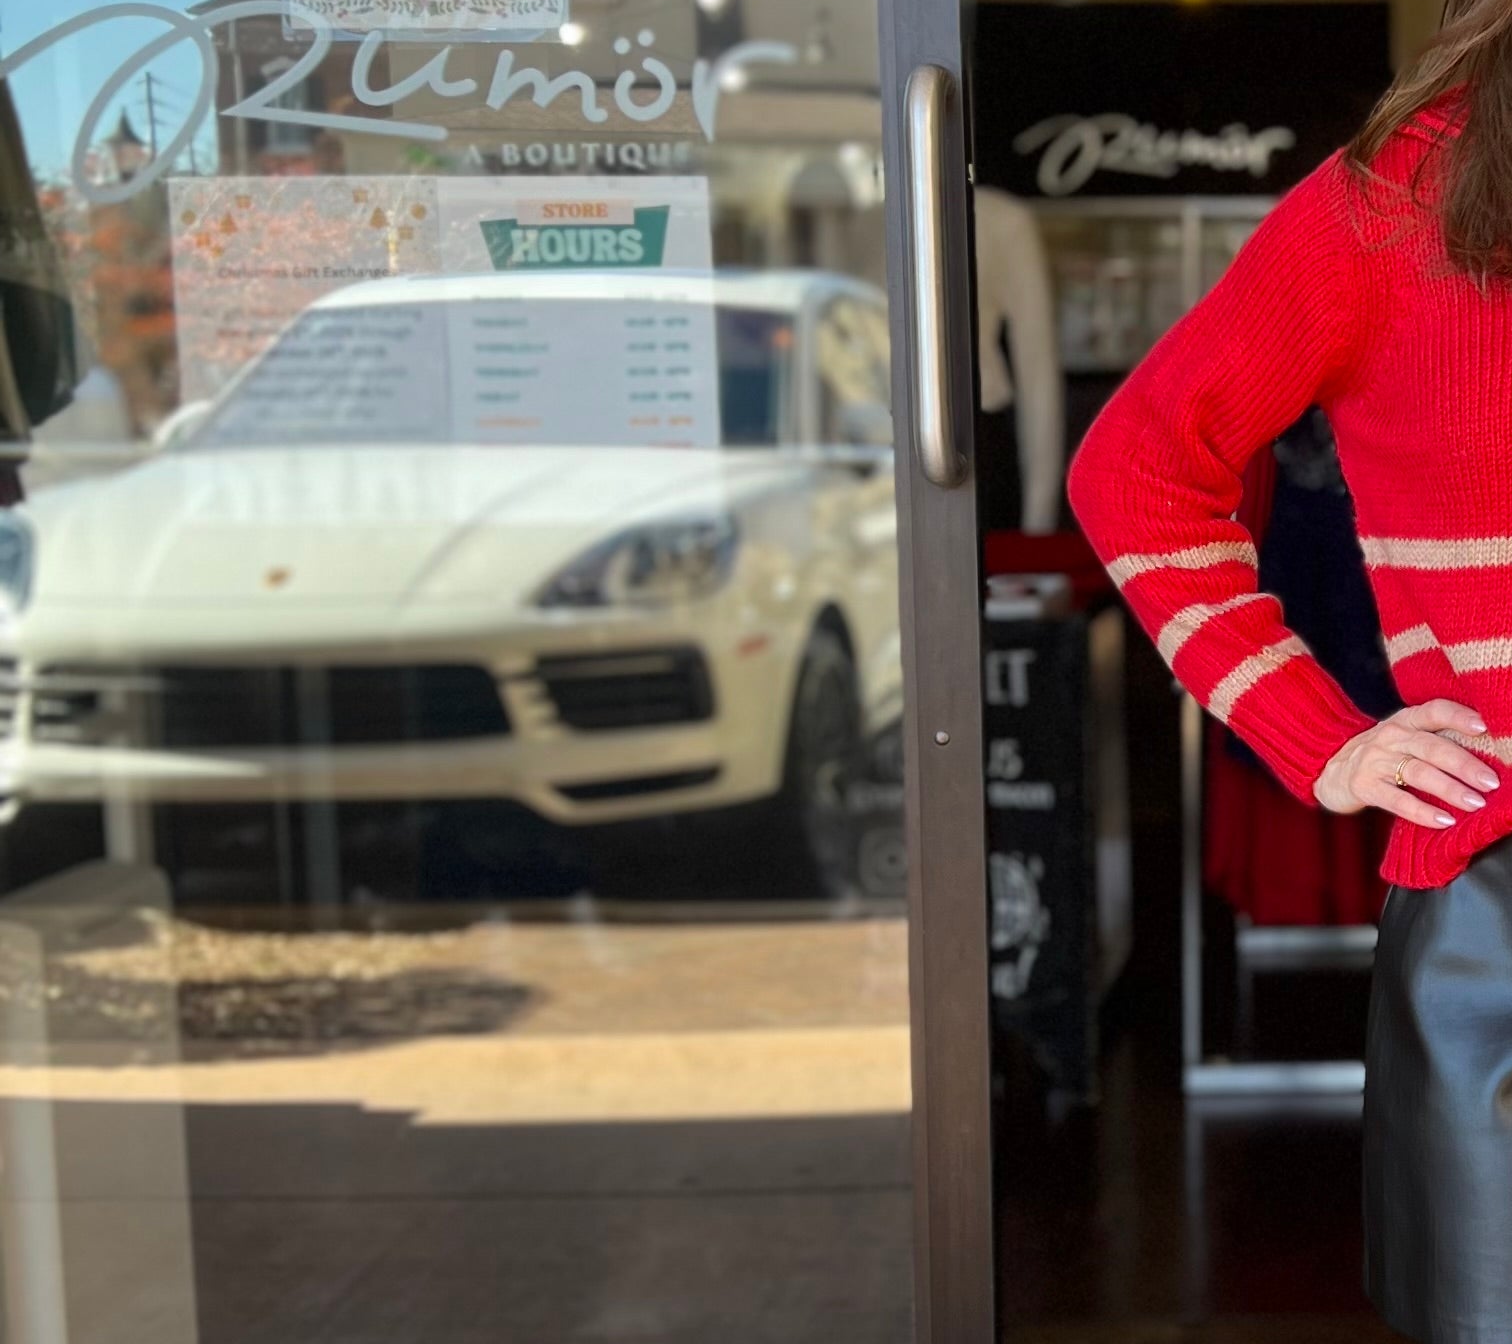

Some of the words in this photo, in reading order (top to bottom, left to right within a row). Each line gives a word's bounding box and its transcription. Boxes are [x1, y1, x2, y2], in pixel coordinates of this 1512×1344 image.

[463, 143, 484, 164] A
[542, 203, 609, 218] STORE
[510, 227, 645, 262] HOURS
[292, 266, 319, 279] Gift
[322, 266, 389, 281] Exchange
